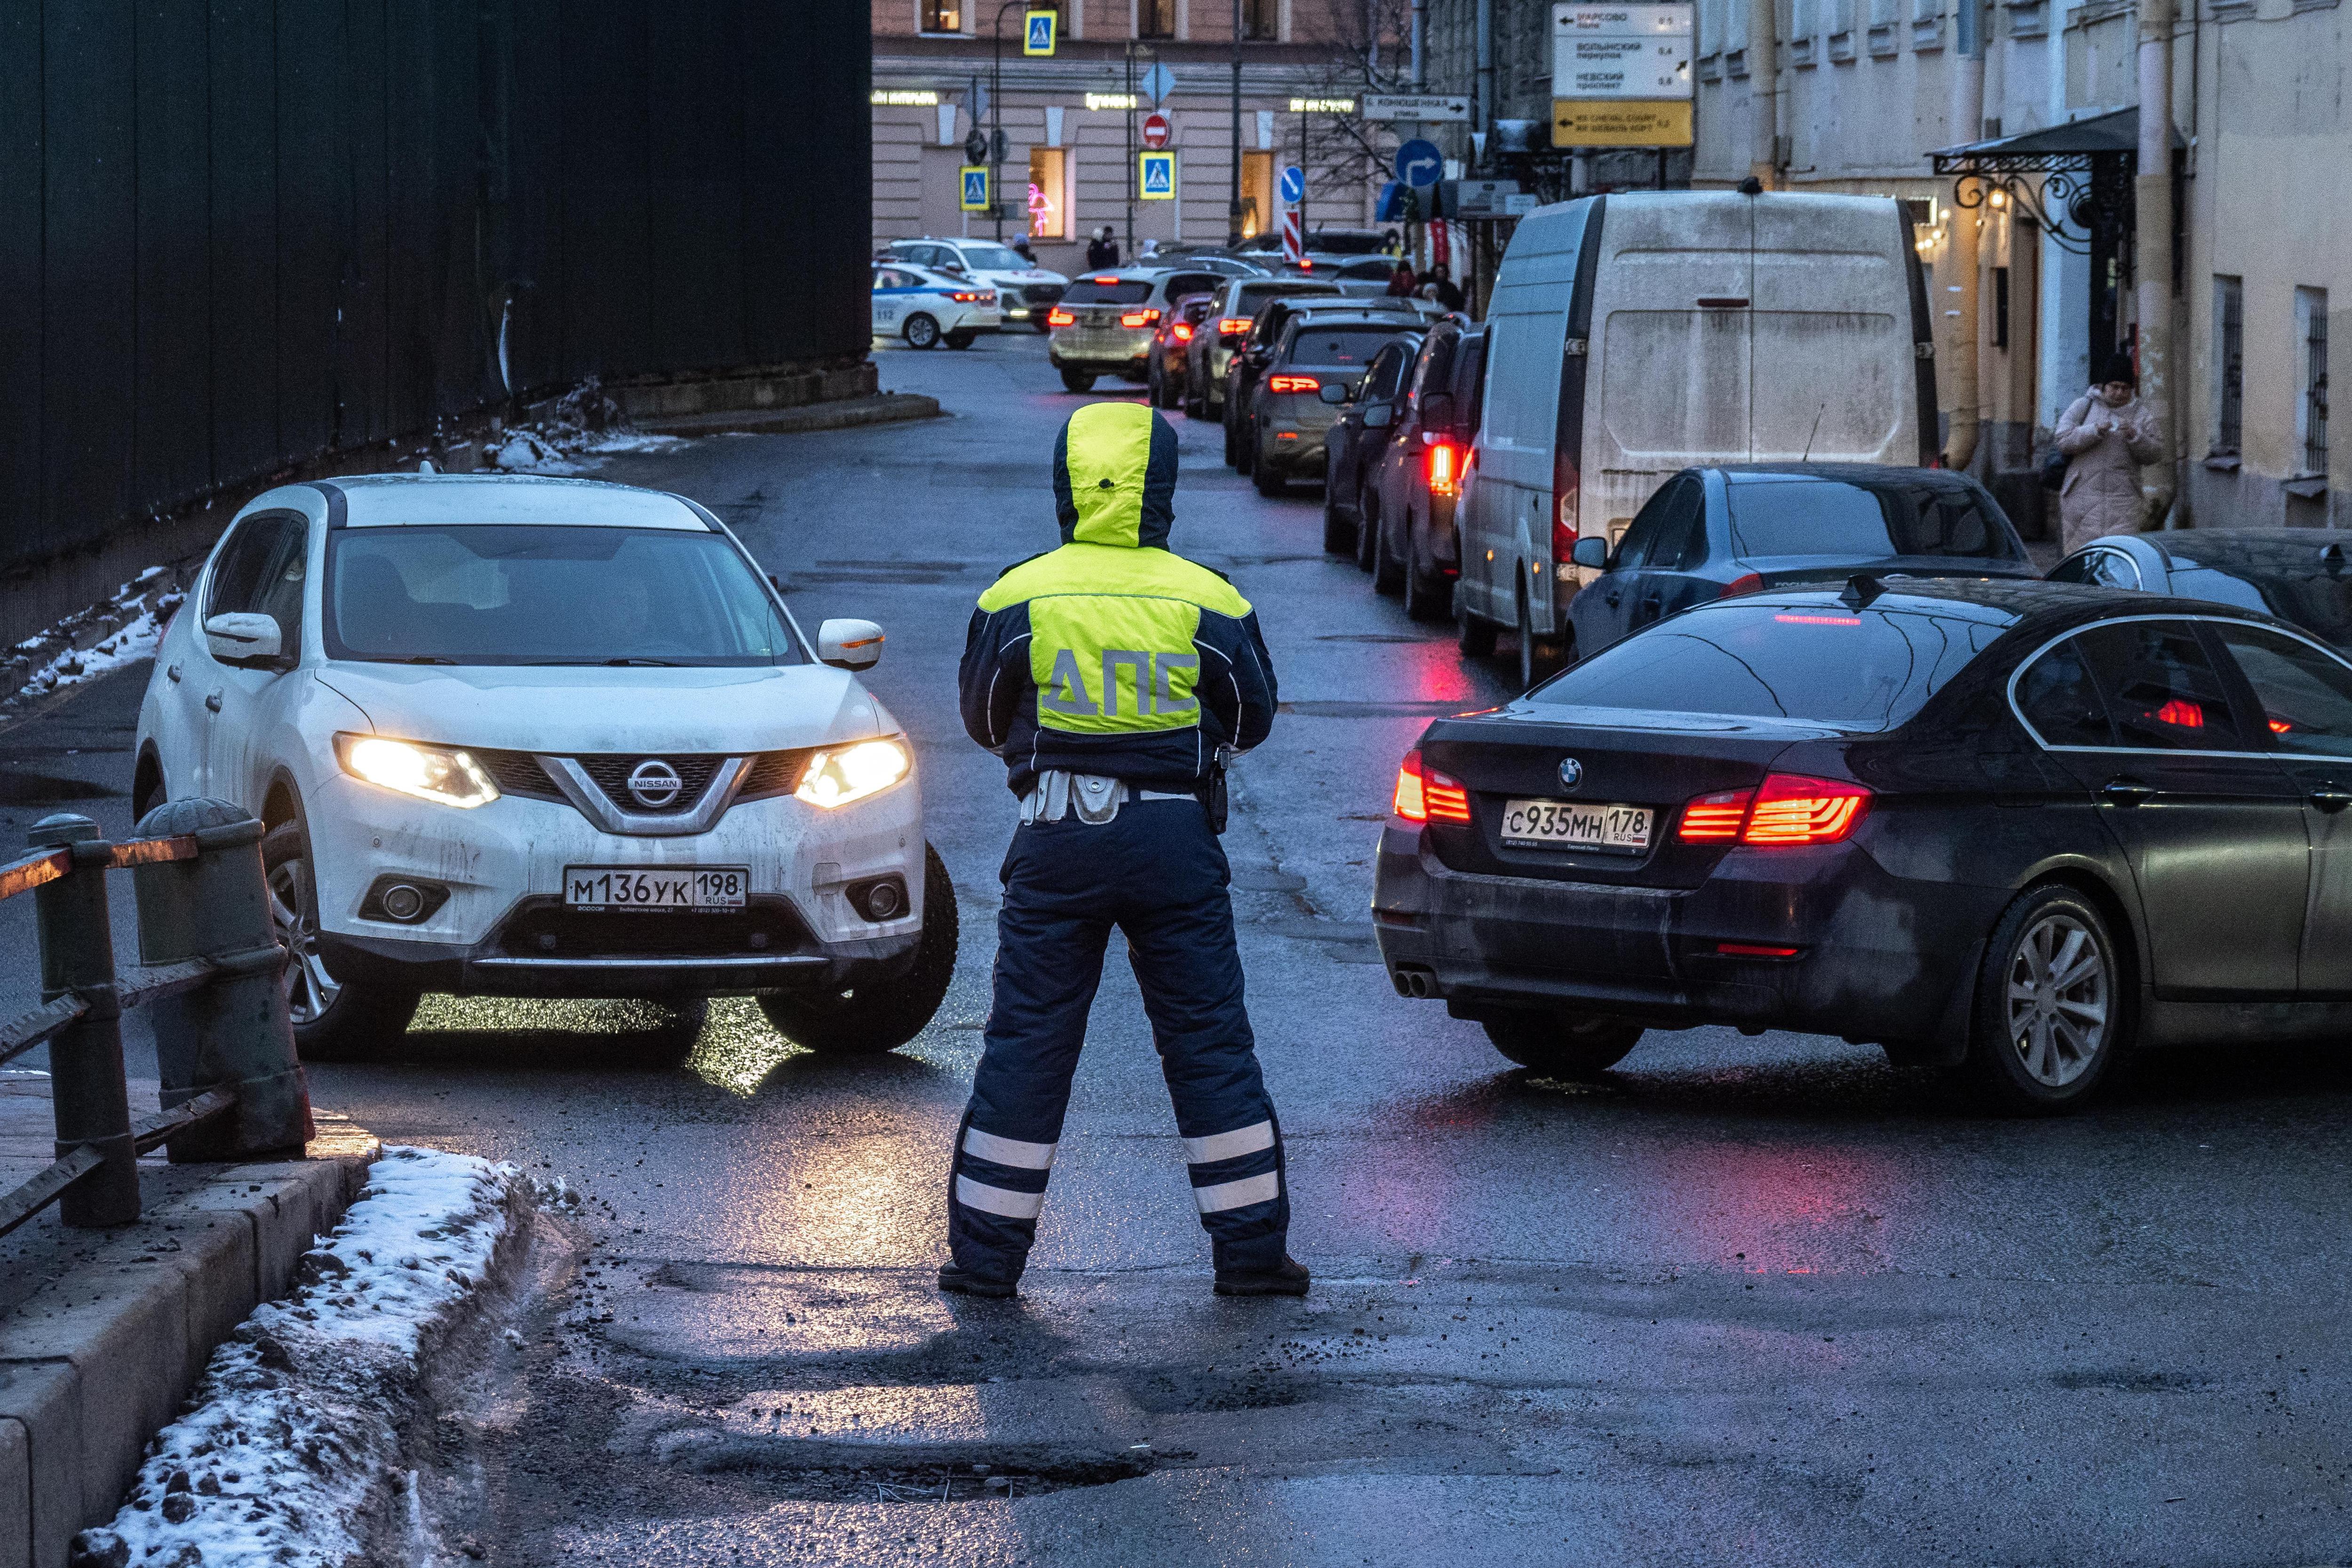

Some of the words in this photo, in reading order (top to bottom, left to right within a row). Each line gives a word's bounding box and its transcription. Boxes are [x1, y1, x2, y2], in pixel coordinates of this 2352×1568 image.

[1576, 72, 1624, 81] НЕВСКИЙ
[1042, 649, 1198, 716] ДПС
[634, 780, 677, 788] NISSAN
[1609, 809, 1645, 834] 178
[1613, 833, 1632, 842] RUS
[697, 873, 739, 896] 198
[705, 896, 727, 905] RUS
